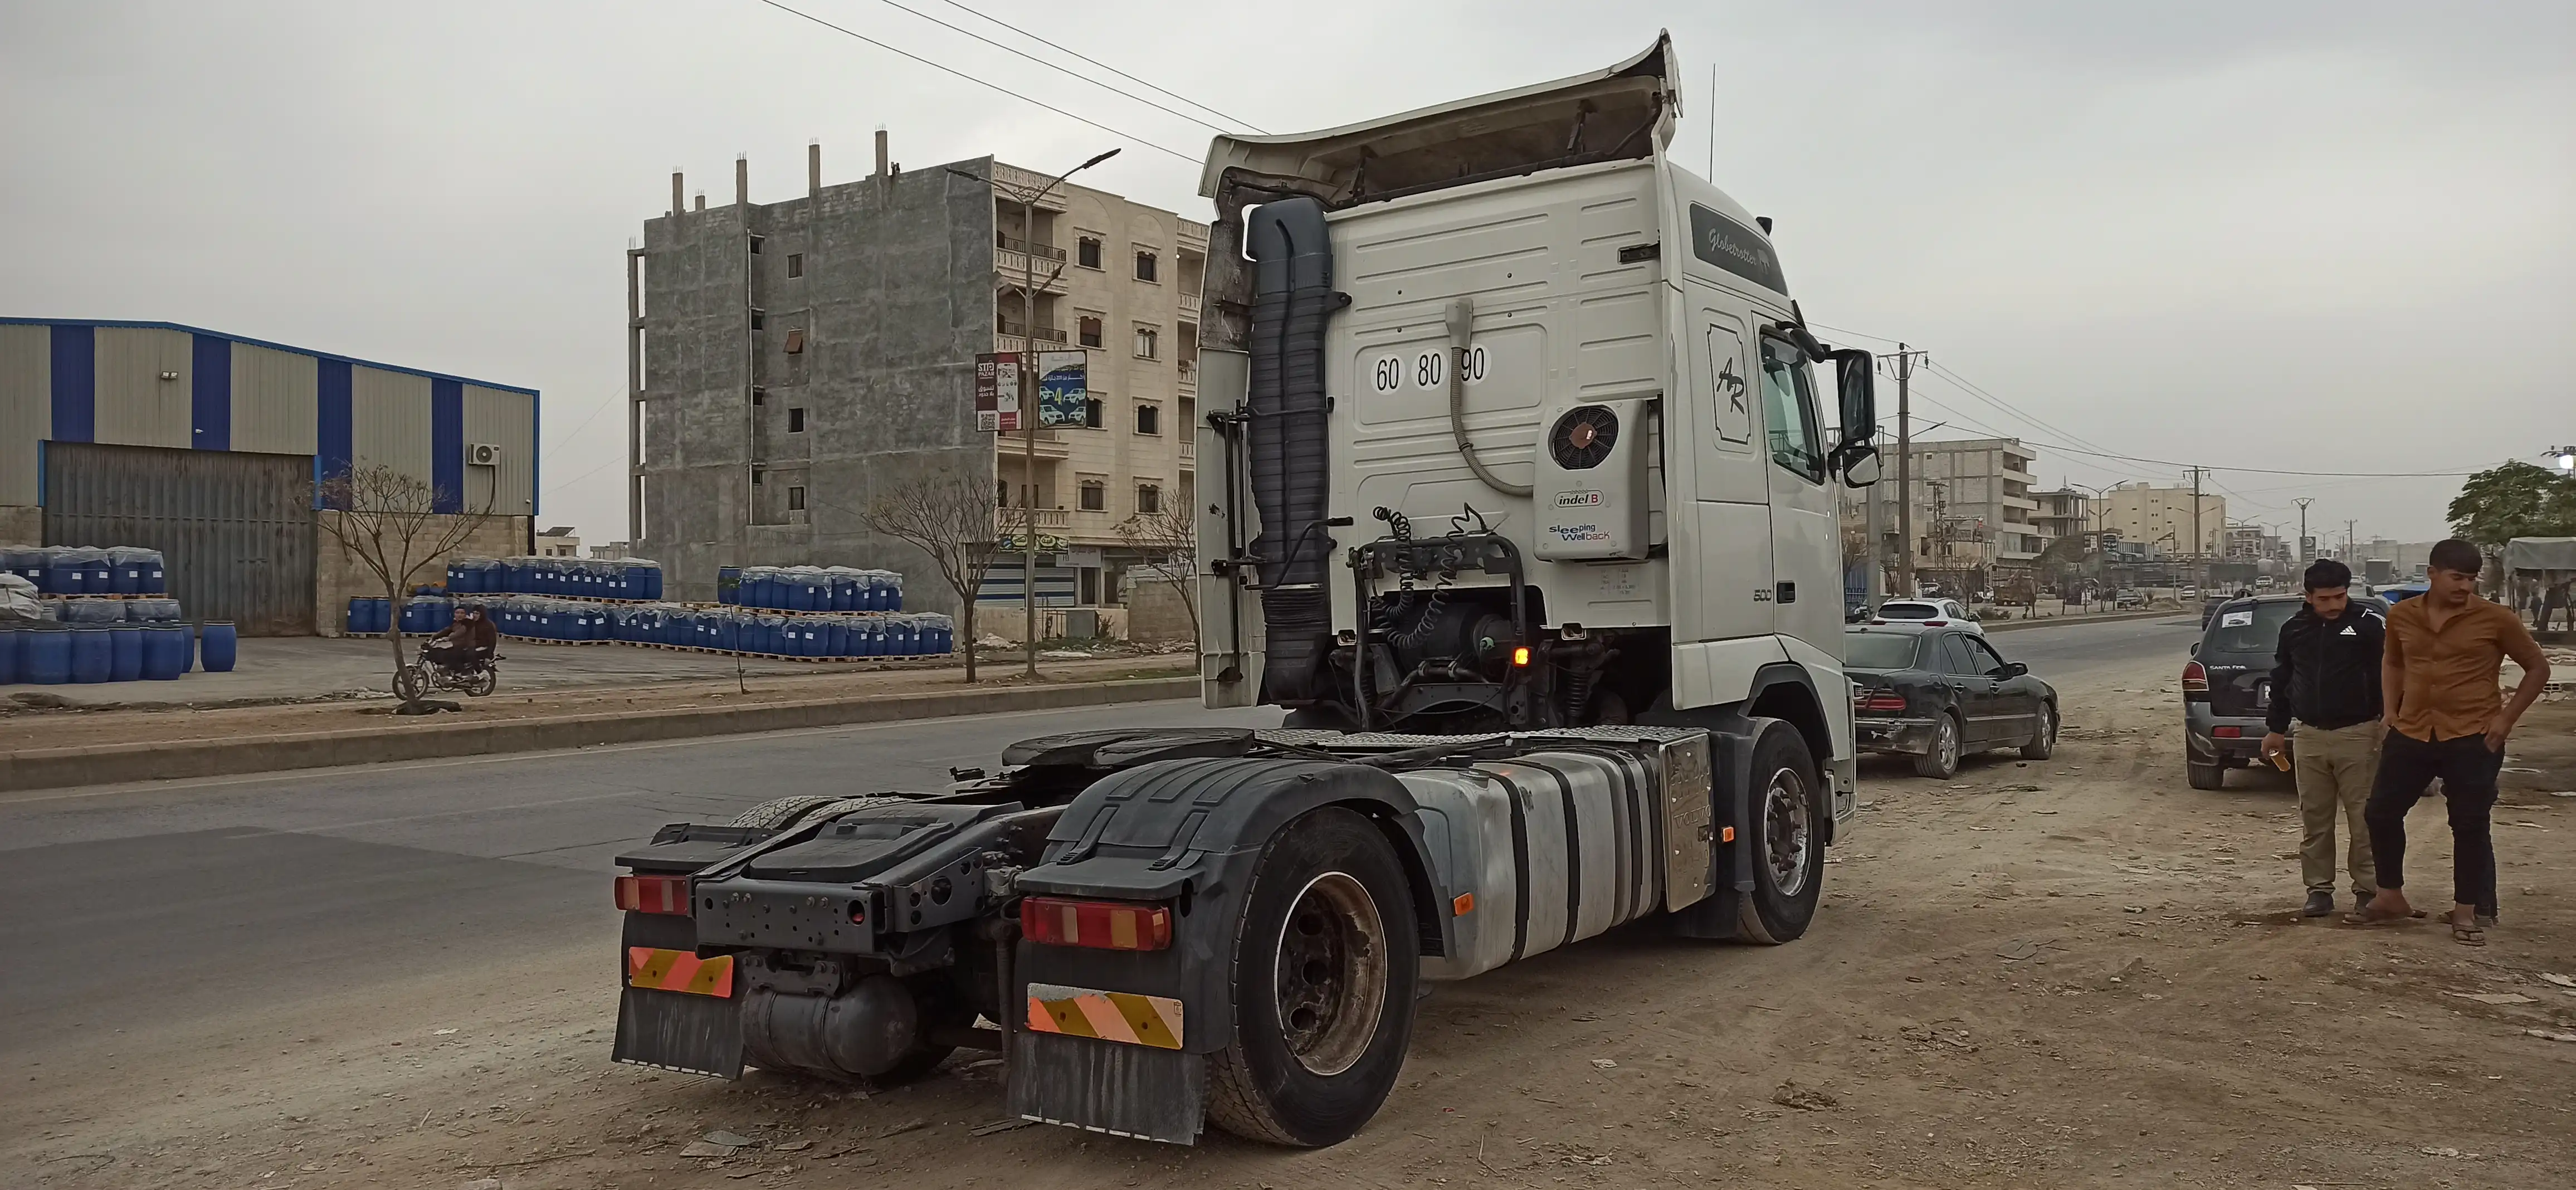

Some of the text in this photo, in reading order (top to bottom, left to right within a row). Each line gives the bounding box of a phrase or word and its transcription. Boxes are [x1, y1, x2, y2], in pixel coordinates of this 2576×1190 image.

[1709, 228, 1757, 266] Globetrotter
[1377, 347, 1485, 391] 60 80 90
[1054, 387, 1062, 406] 4
[1559, 494, 1598, 505] indel B
[1549, 524, 1596, 534] sleeping
[1754, 589, 1772, 602] 500
